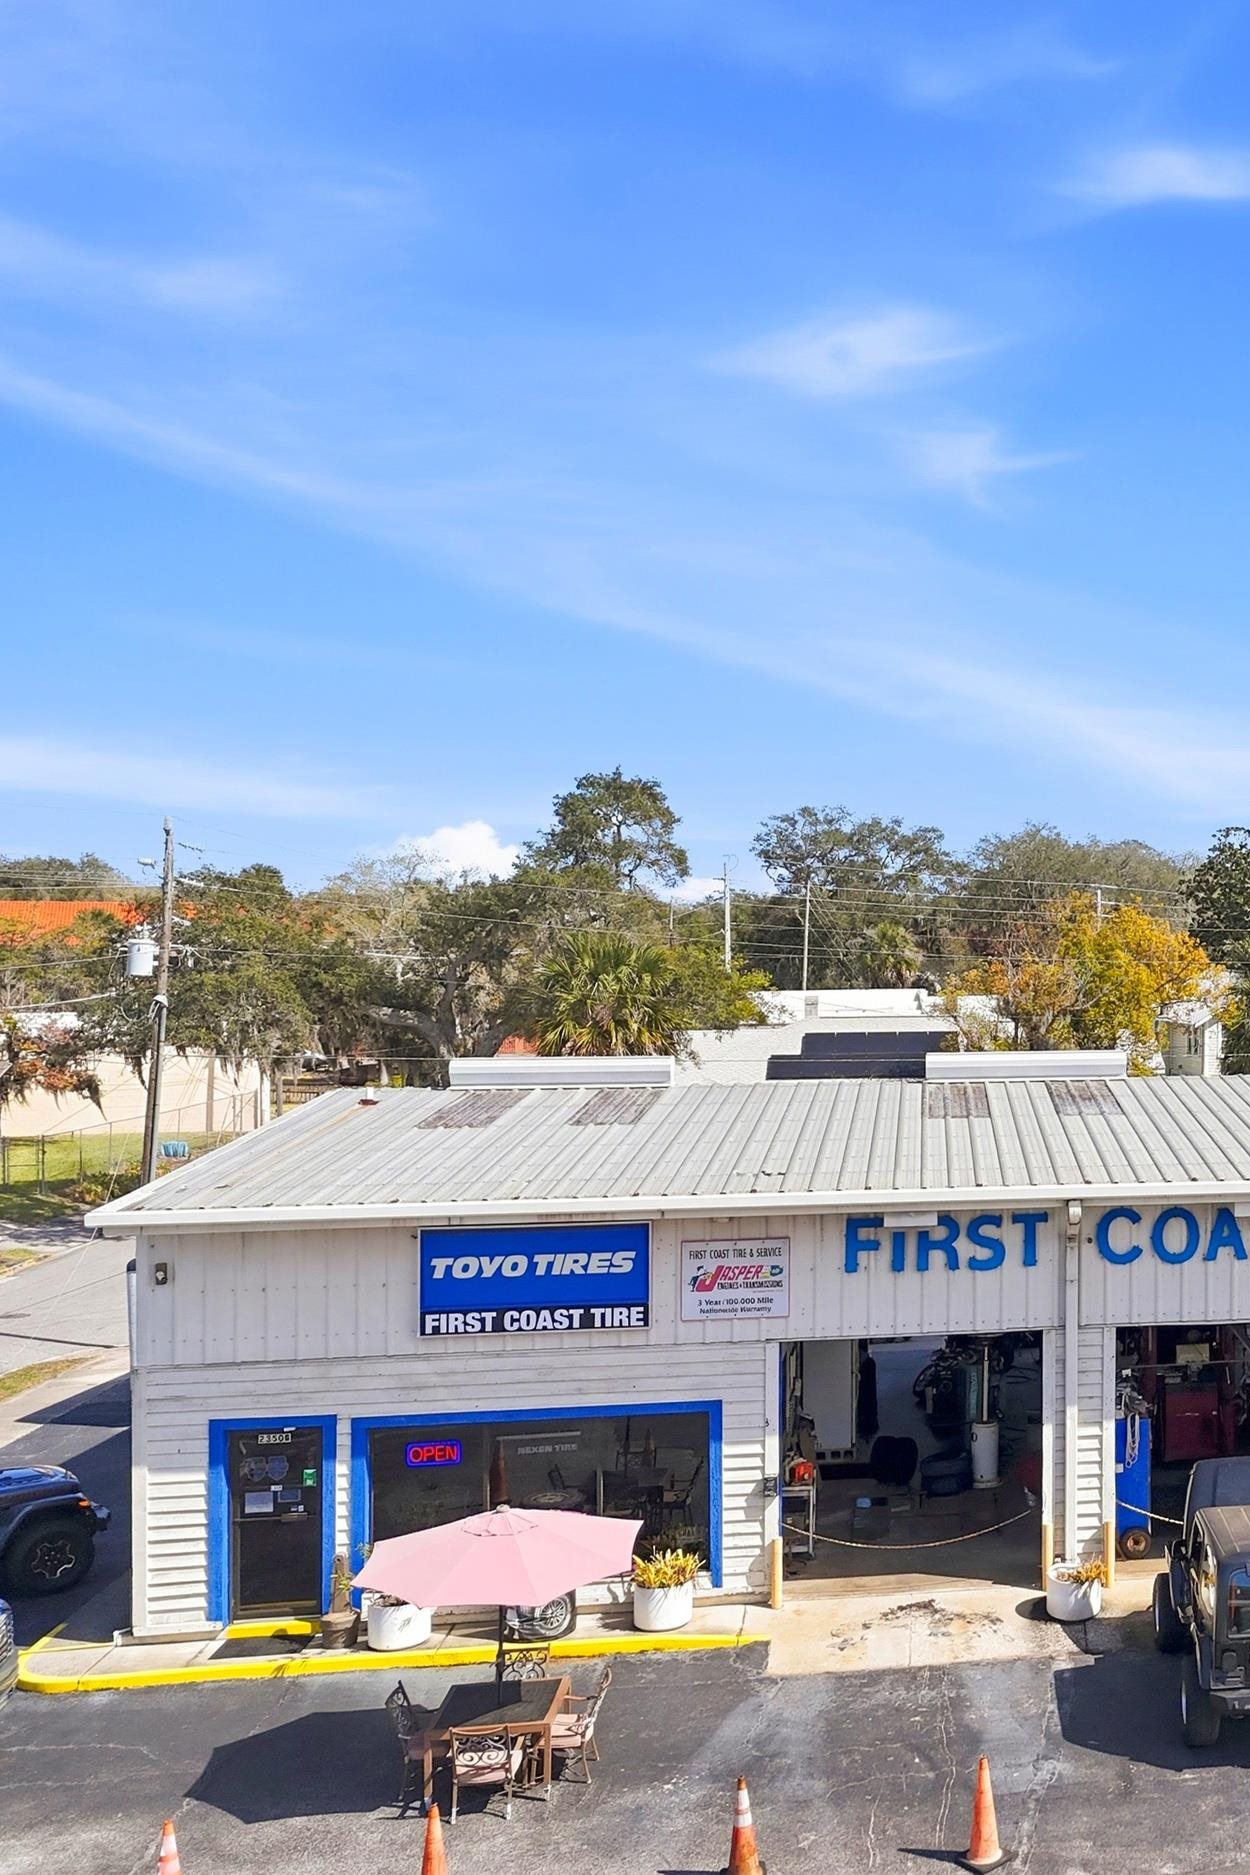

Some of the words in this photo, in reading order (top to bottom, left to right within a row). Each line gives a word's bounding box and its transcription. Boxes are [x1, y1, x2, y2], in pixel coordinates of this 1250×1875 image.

[689, 1250, 707, 1260] FIRST
[710, 1249, 729, 1259] COAST
[733, 1248, 747, 1258] TIRE
[749, 1248, 754, 1258] &
[756, 1247, 782, 1257] SERVICE
[845, 1212, 1048, 1273] FIRST
[430, 1255, 528, 1279] TOYO
[533, 1251, 637, 1276] TIRES
[696, 1265, 764, 1292] JASPER
[424, 1312, 497, 1334] FIRST
[503, 1309, 584, 1331] COAST
[590, 1306, 645, 1327] TIRE
[409, 1446, 458, 1464] OPEN
